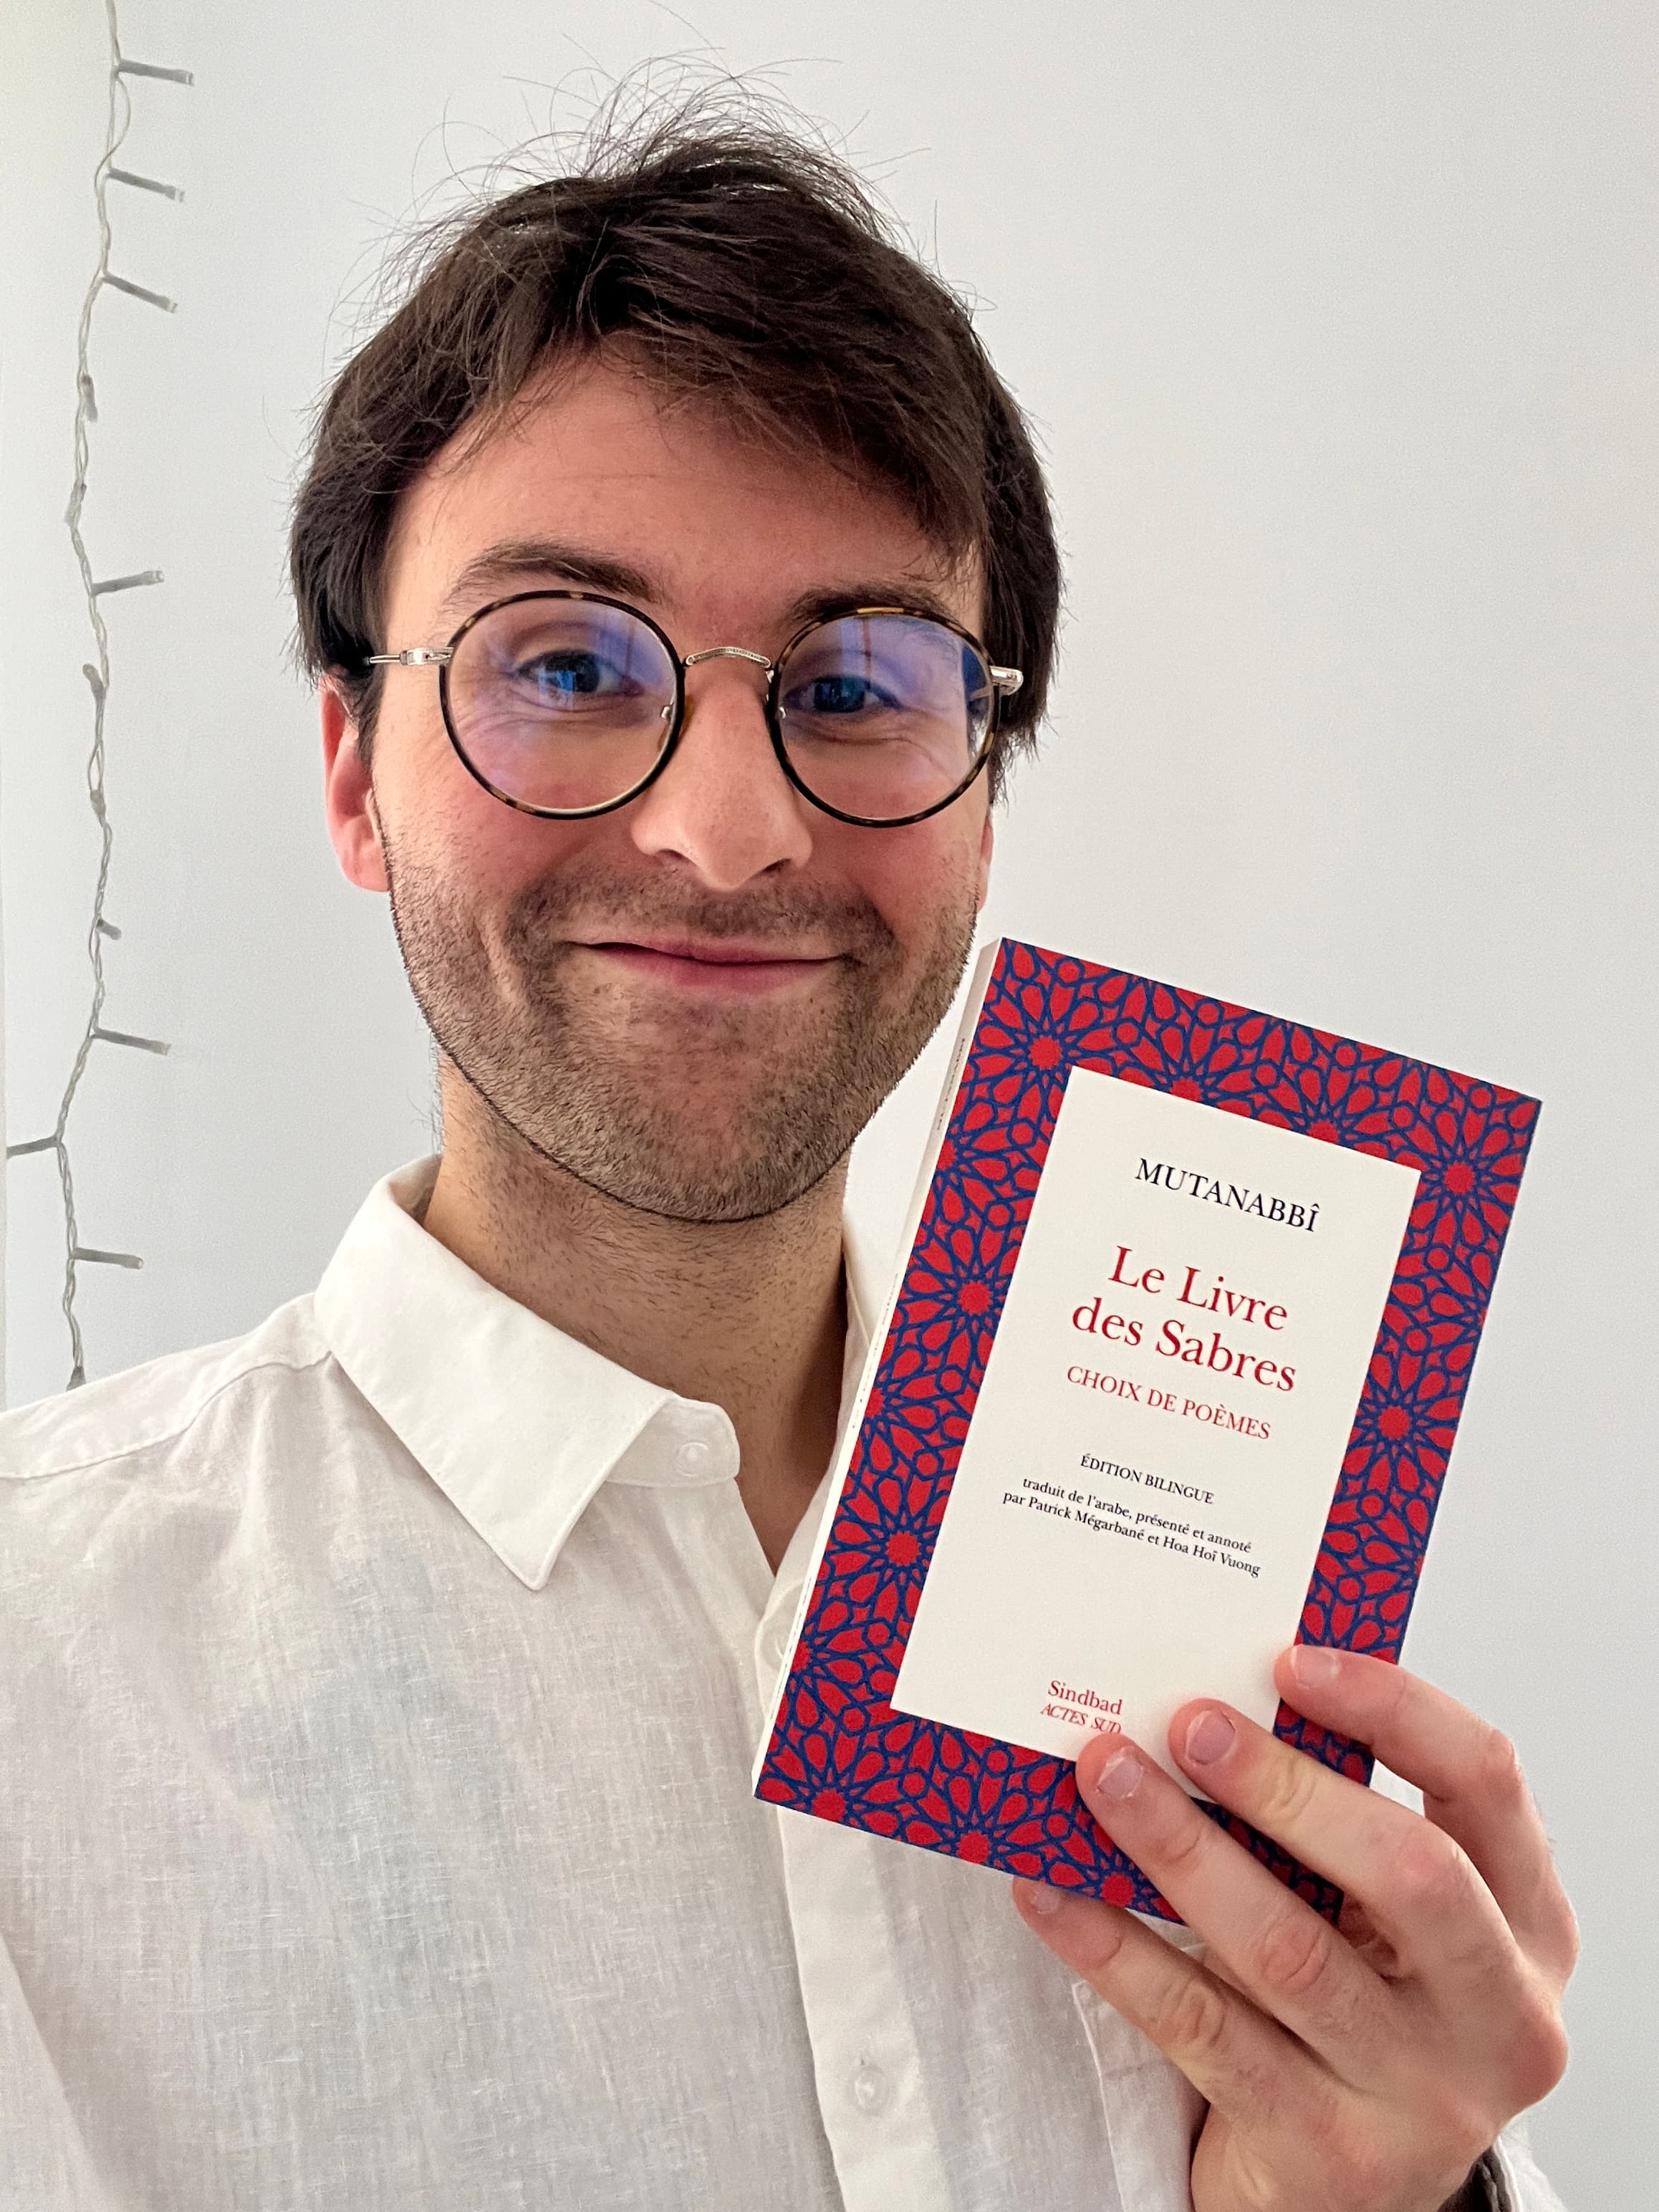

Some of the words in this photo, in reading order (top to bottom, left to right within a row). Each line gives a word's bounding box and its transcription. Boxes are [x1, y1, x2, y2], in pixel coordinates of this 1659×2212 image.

[1134, 1158, 1321, 1233] MUTANABBÎ
[1107, 1245, 1165, 1294] Le
[1175, 1266, 1289, 1331] Livre
[1072, 1297, 1143, 1347] des
[1155, 1319, 1297, 1392] Sabres
[1067, 1365, 1142, 1403] CHOIX
[1147, 1388, 1178, 1413] DE
[1182, 1398, 1271, 1440] POÈMES
[1023, 1478, 1065, 1499] traduit
[1067, 1490, 1085, 1504] de
[1135, 1512, 1190, 1535] présenté
[1192, 1529, 1204, 1540] et
[1207, 1533, 1251, 1553] annoté
[1080, 1453, 1143, 1484] ÉDITION
[1145, 1473, 1214, 1504] BILINGUE
[1003, 1492, 1026, 1505] par
[1028, 1496, 1072, 1519] Patrick
[1074, 1509, 1145, 1540] Mégarbané
[1148, 1534, 1160, 1545] et
[1163, 1535, 1189, 1554] Hoa
[1221, 1552, 1261, 1578] Vuong
[1040, 1703, 1089, 1726] ACTES
[1090, 1716, 1122, 1734] SUD
[1047, 1680, 1123, 1715] Sindbad
